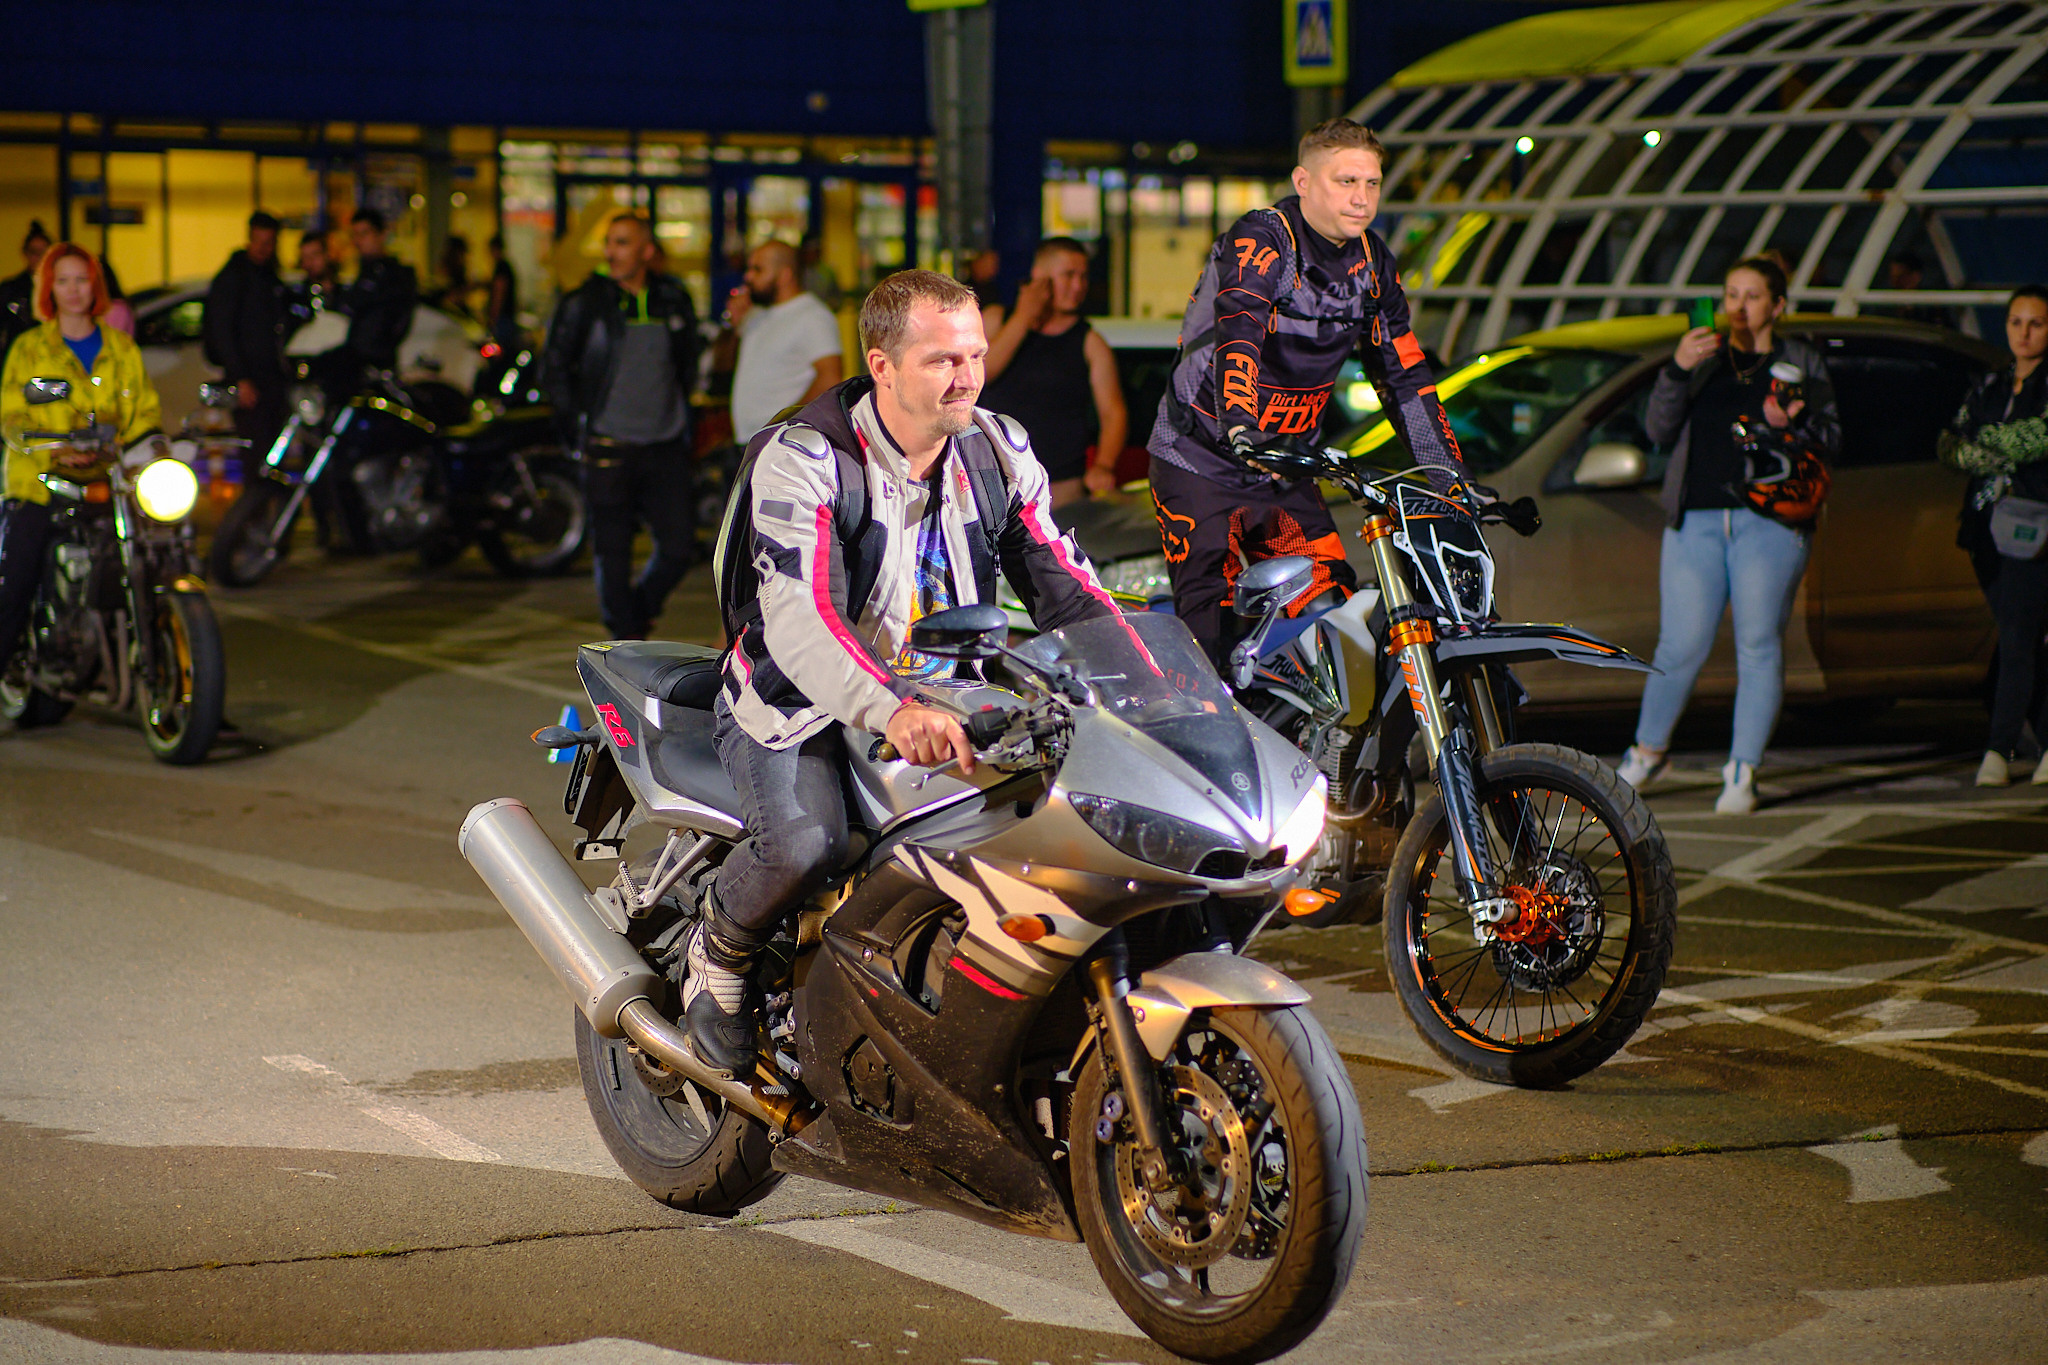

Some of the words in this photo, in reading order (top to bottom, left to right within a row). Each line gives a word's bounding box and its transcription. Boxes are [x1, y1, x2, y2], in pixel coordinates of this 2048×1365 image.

[1223, 352, 1255, 415] FOX
[1268, 392, 1298, 407] Dirt
[1258, 401, 1327, 434] FOX
[596, 702, 637, 748] R6
[1290, 755, 1311, 790] R6
